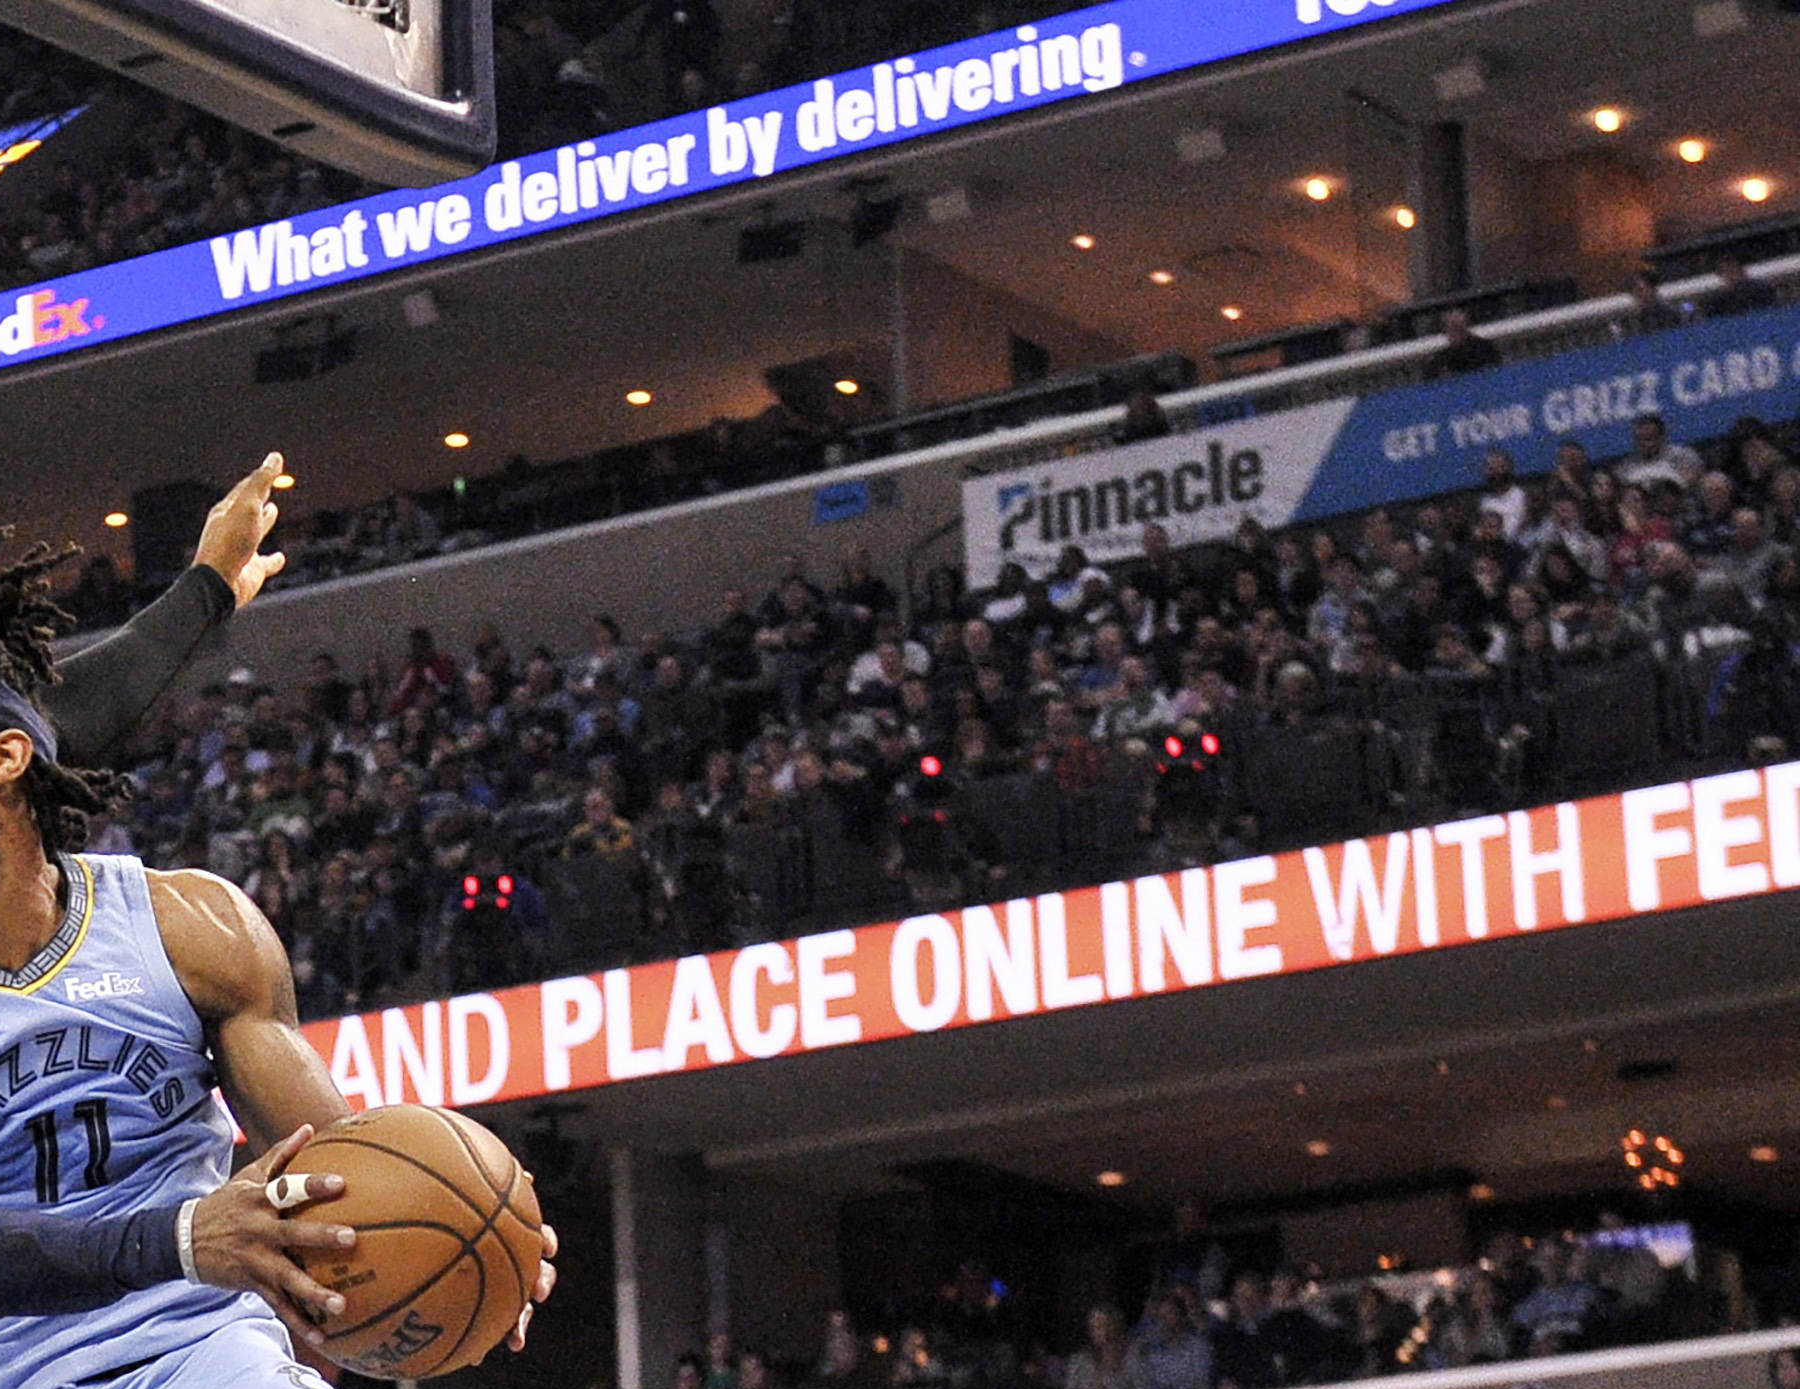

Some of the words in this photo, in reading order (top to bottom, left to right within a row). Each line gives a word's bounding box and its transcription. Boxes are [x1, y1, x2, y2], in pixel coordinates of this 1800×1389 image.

[210, 209, 368, 300] What
[376, 193, 471, 259] we
[484, 141, 695, 232] deliver
[708, 107, 782, 177] by
[1383, 423, 1439, 462] GET
[1450, 404, 1532, 448] YOUR
[1543, 370, 1660, 434] GRIZZ
[1671, 346, 1781, 405] CARD
[1000, 440, 1266, 549] Pinnacle
[63, 971, 145, 1001] FedEx
[330, 993, 509, 1108] AND
[541, 929, 861, 1091] PLACE
[890, 856, 1283, 1033] ONLINE
[1304, 802, 1586, 960] WITH
[22, 1098, 111, 1204] 11
